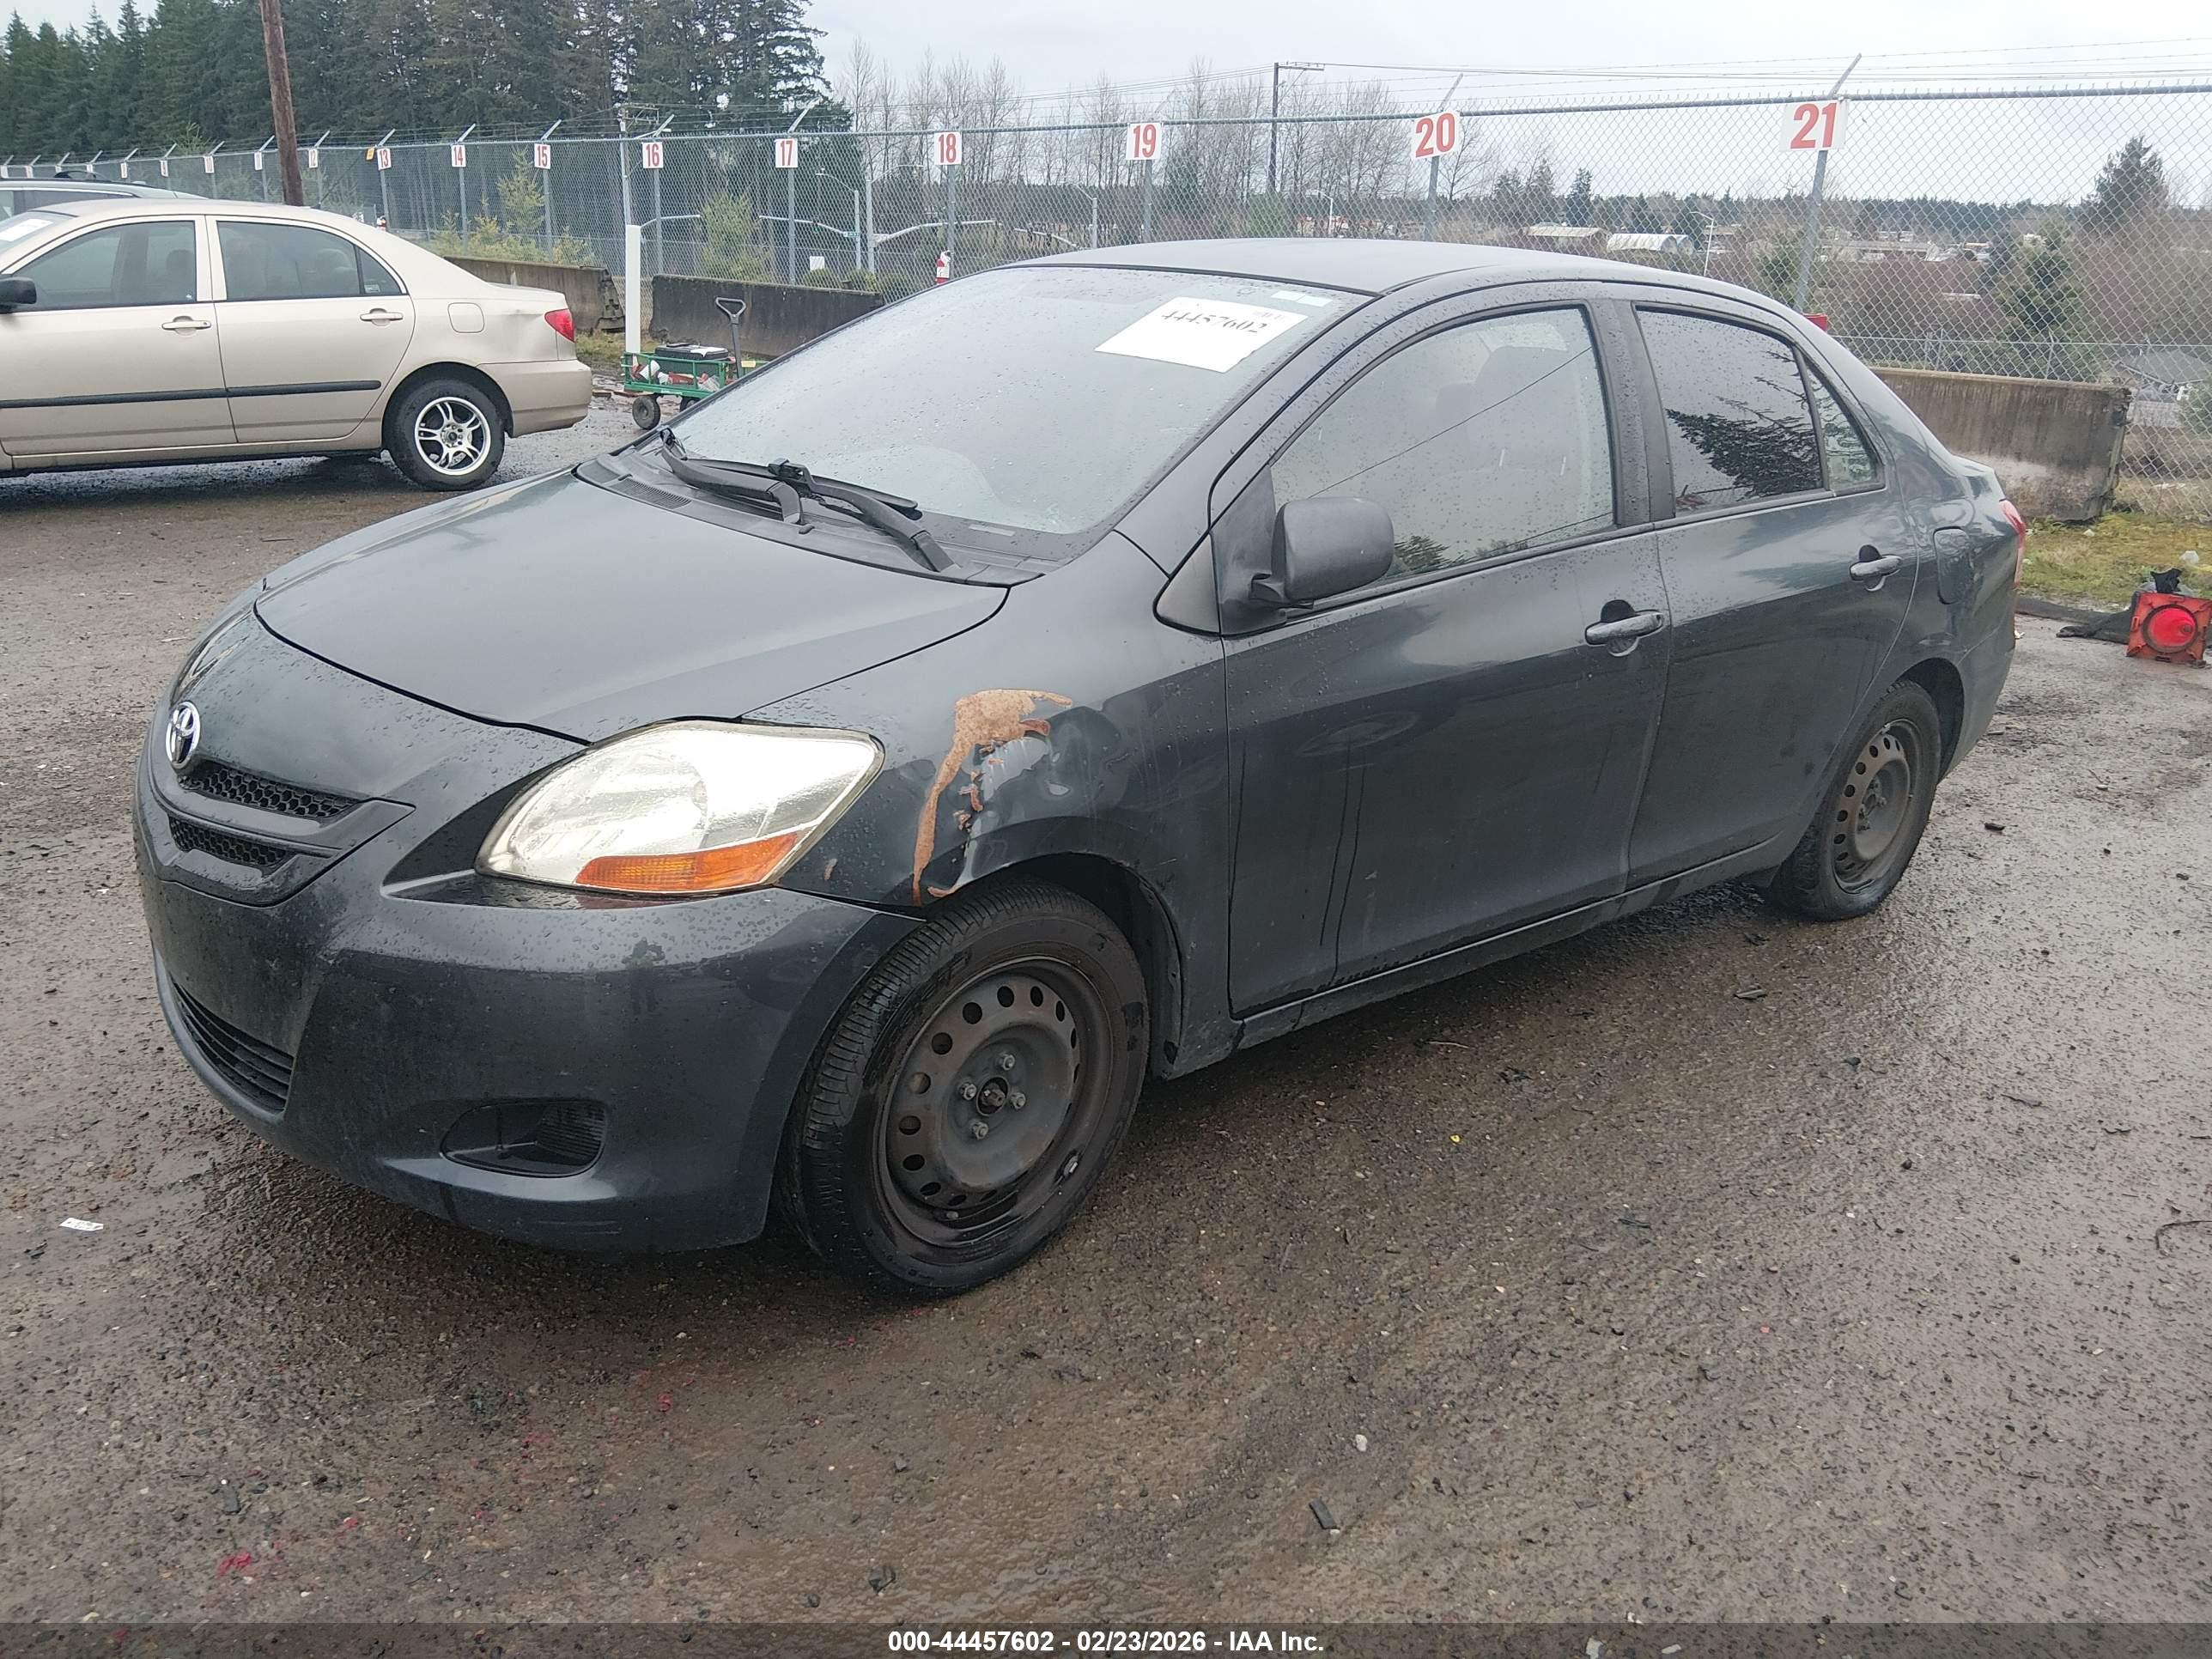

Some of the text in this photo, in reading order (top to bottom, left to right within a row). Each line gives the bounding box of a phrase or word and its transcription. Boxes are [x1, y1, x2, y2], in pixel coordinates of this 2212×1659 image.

[1415, 112, 1455, 158] 20
[1790, 102, 1837, 149] 21
[780, 140, 793, 166] 17
[939, 133, 957, 163] 18
[1133, 124, 1157, 158] 19
[380, 149, 389, 167] 13
[453, 146, 464, 166] 14
[537, 145, 548, 167] 15
[646, 143, 659, 167] 16
